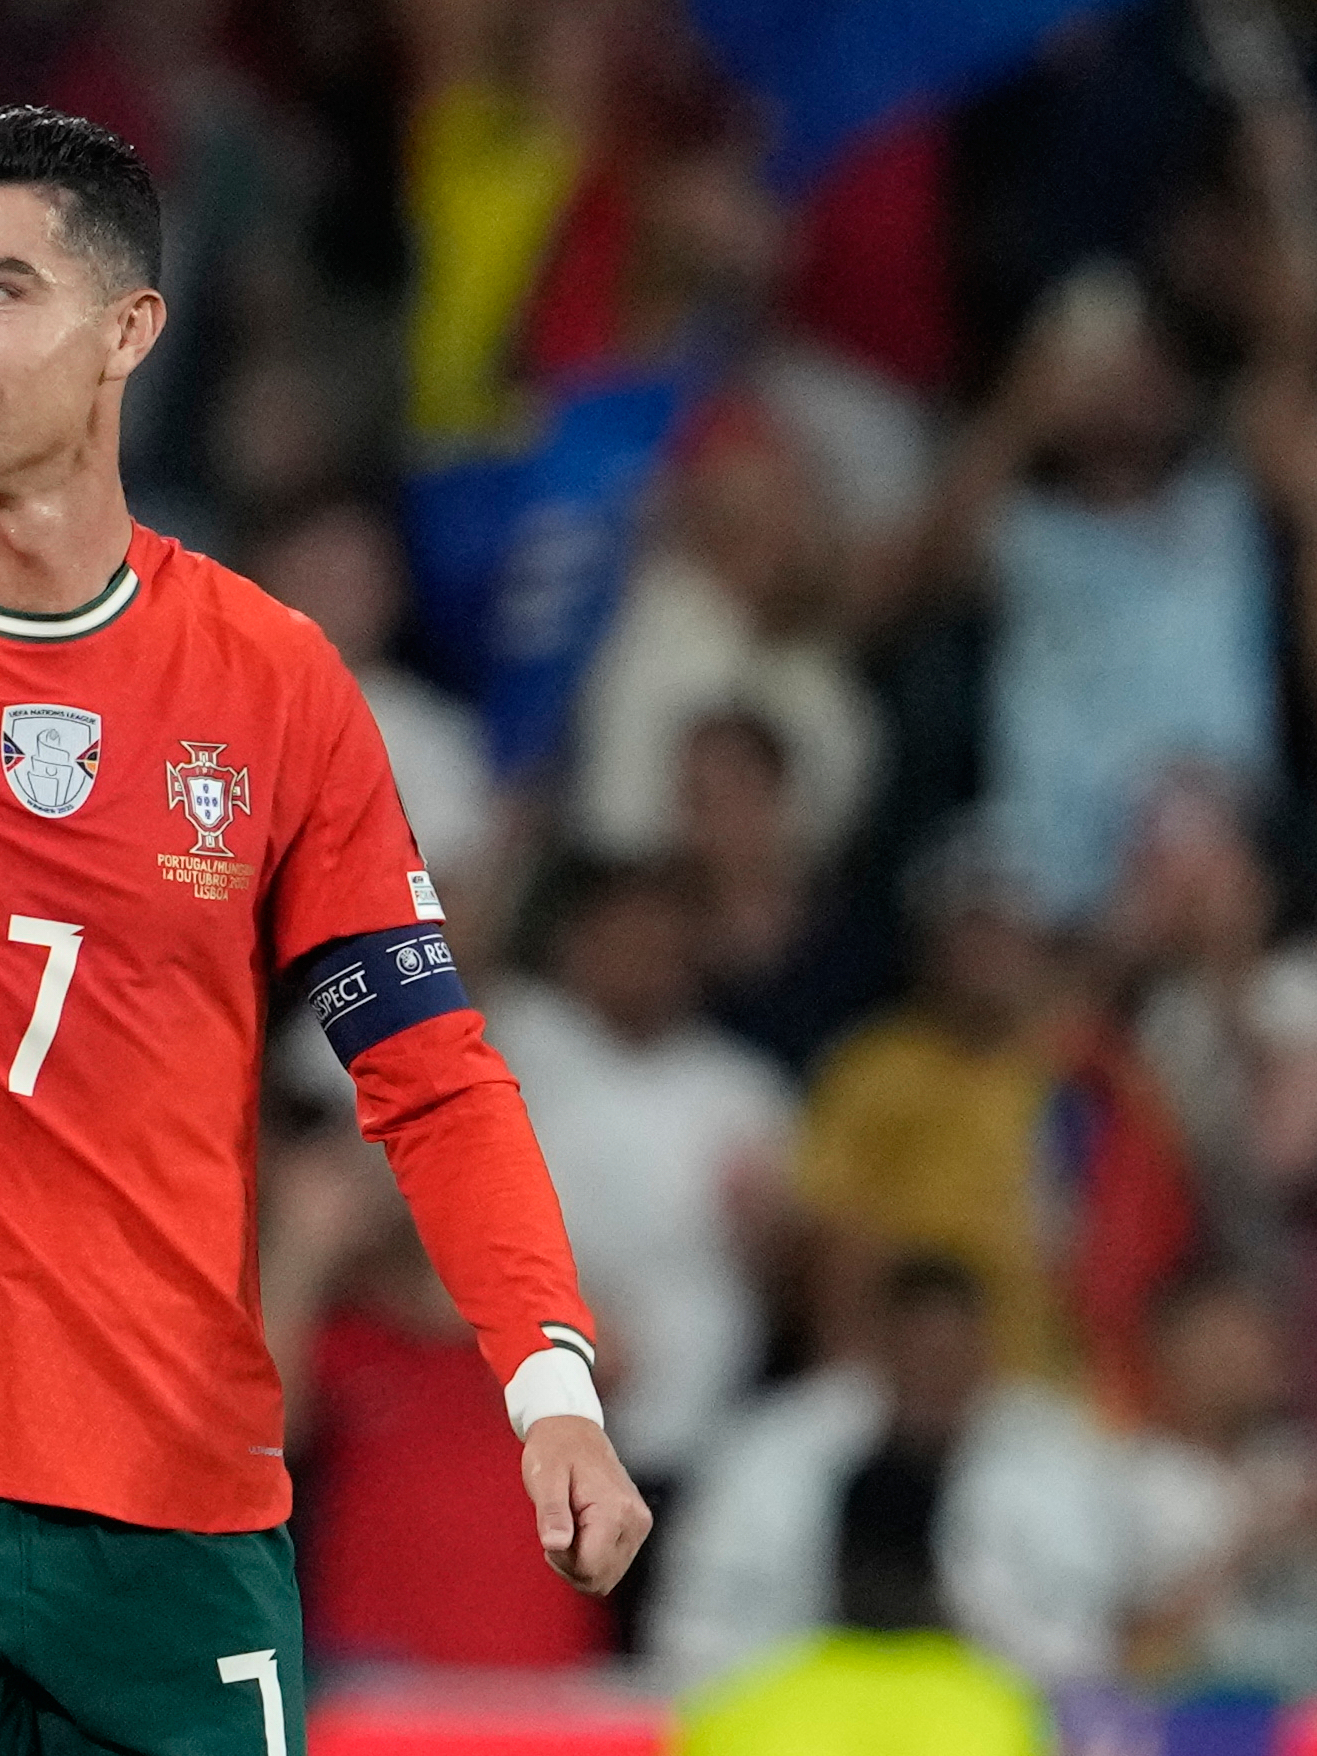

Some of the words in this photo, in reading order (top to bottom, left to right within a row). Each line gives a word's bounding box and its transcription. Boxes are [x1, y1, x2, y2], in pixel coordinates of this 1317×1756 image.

[8, 710, 28, 718] UEFA
[30, 709, 65, 718] NATIONS
[66, 711, 96, 725] LEAGUE
[162, 868, 173, 881] 14
[176, 869, 228, 887] OUTUBRO
[194, 884, 228, 901] LISBOA
[8, 914, 84, 1097] 7
